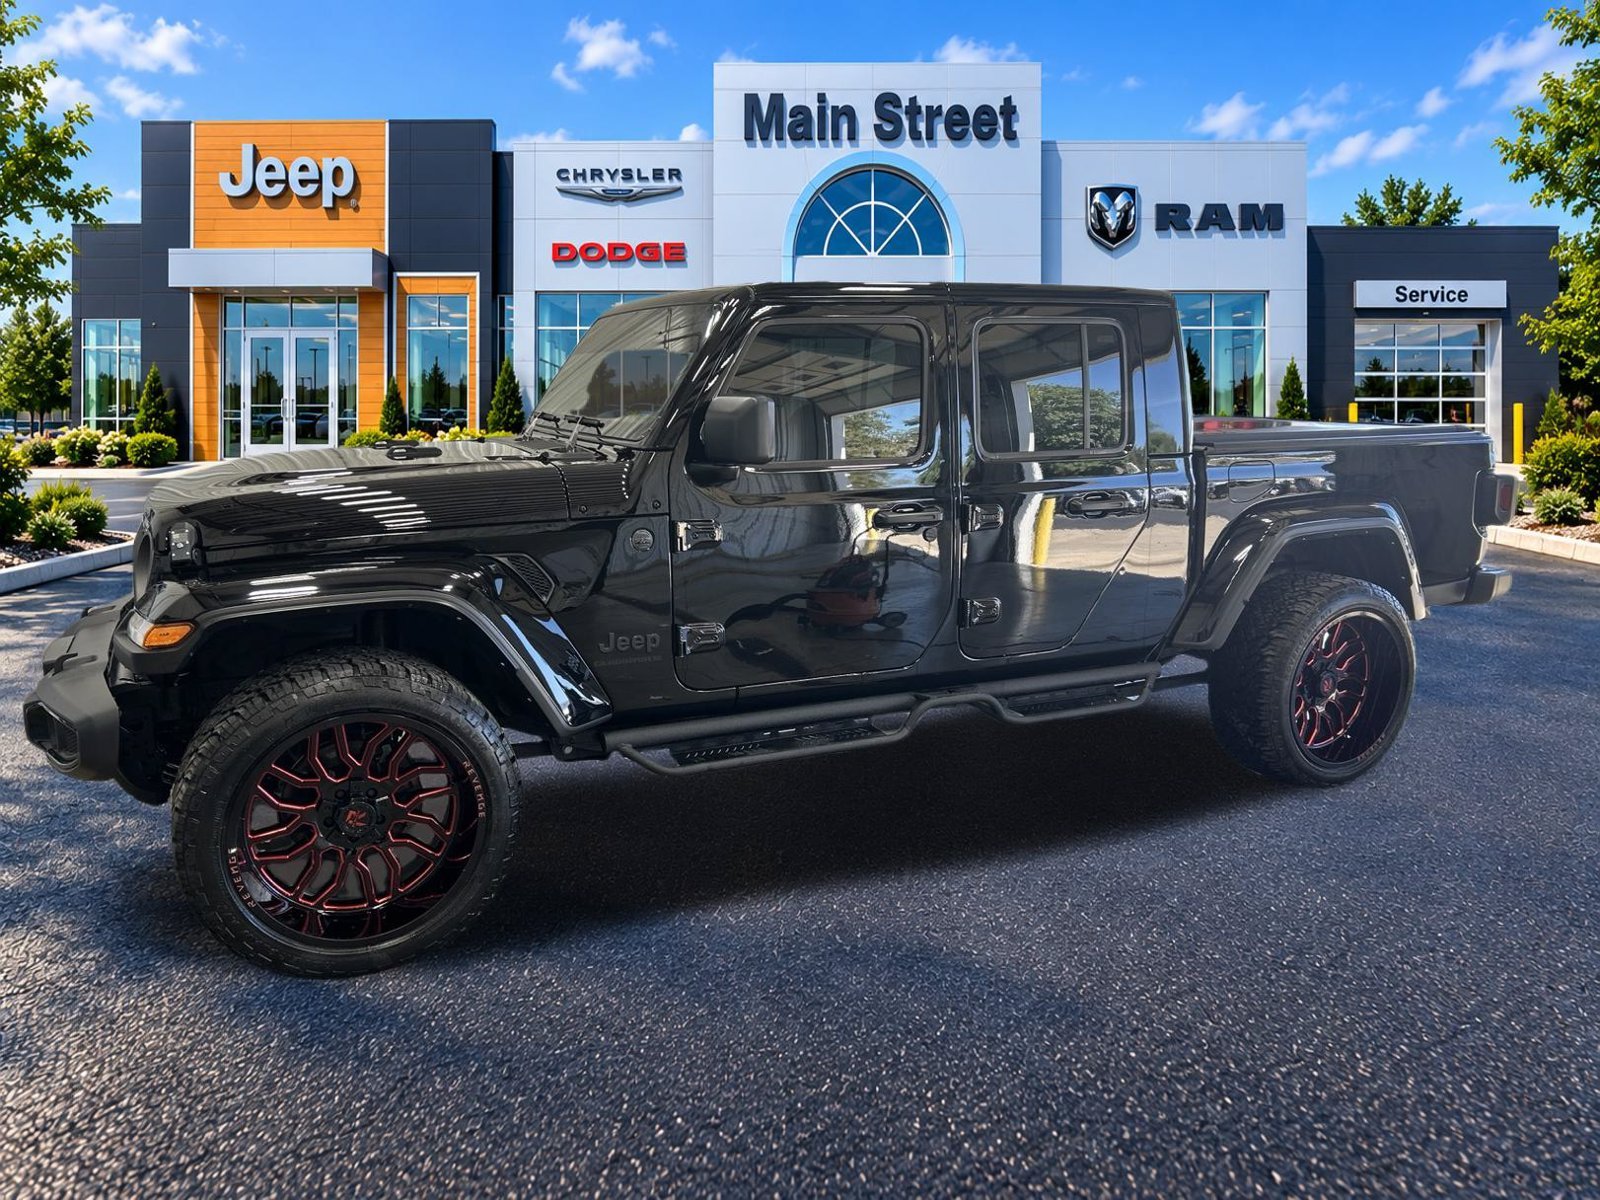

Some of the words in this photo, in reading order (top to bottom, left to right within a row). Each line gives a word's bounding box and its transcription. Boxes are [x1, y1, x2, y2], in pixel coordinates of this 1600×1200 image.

[743, 92, 857, 142] Main
[873, 91, 1018, 142] Street
[218, 143, 355, 208] Jeep
[556, 168, 683, 182] CHRYSLER
[1155, 203, 1284, 232] RAM
[552, 242, 687, 262] DODGE
[1395, 285, 1469, 303] Service
[598, 632, 661, 653] Jeep
[462, 761, 486, 818] REVENGE
